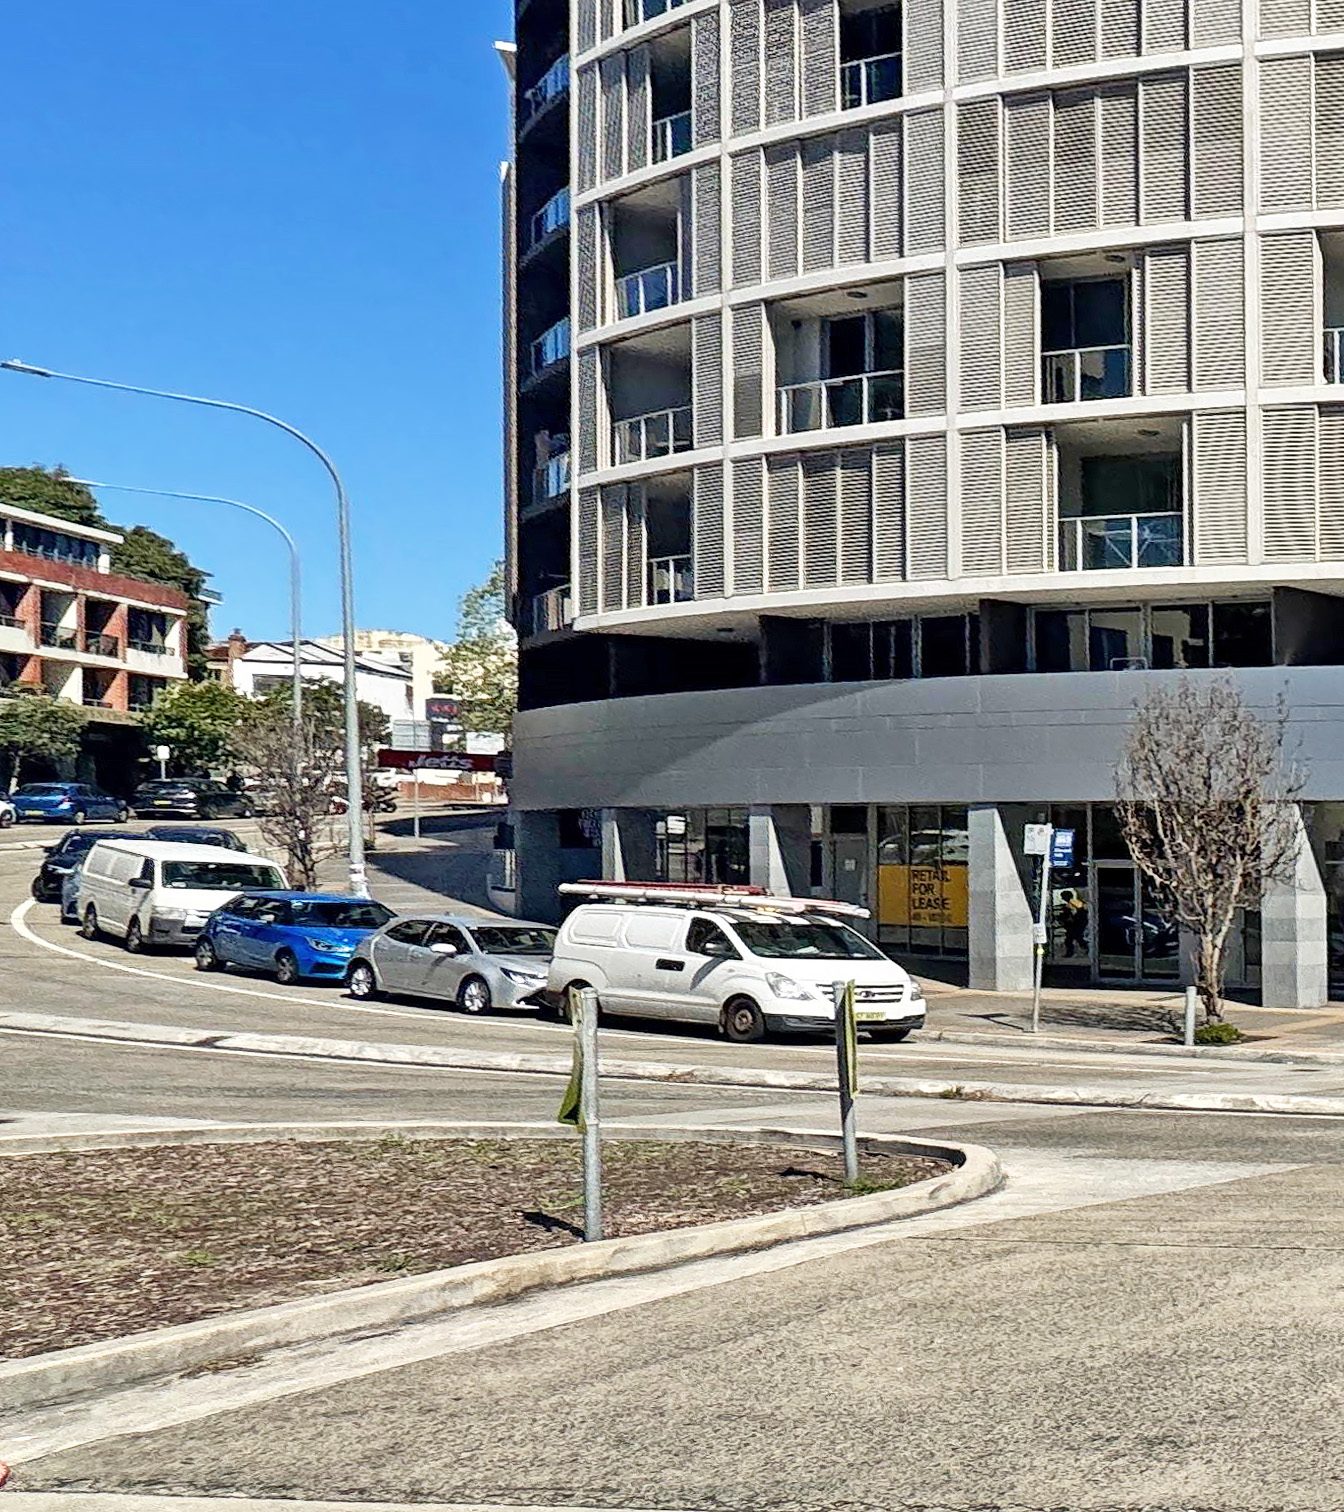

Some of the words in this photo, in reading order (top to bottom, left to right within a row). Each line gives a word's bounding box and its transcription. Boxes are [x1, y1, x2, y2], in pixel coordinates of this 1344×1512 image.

[912, 870, 951, 882] RETAIL
[912, 883, 936, 896] FOR
[912, 897, 951, 910] LEASE
